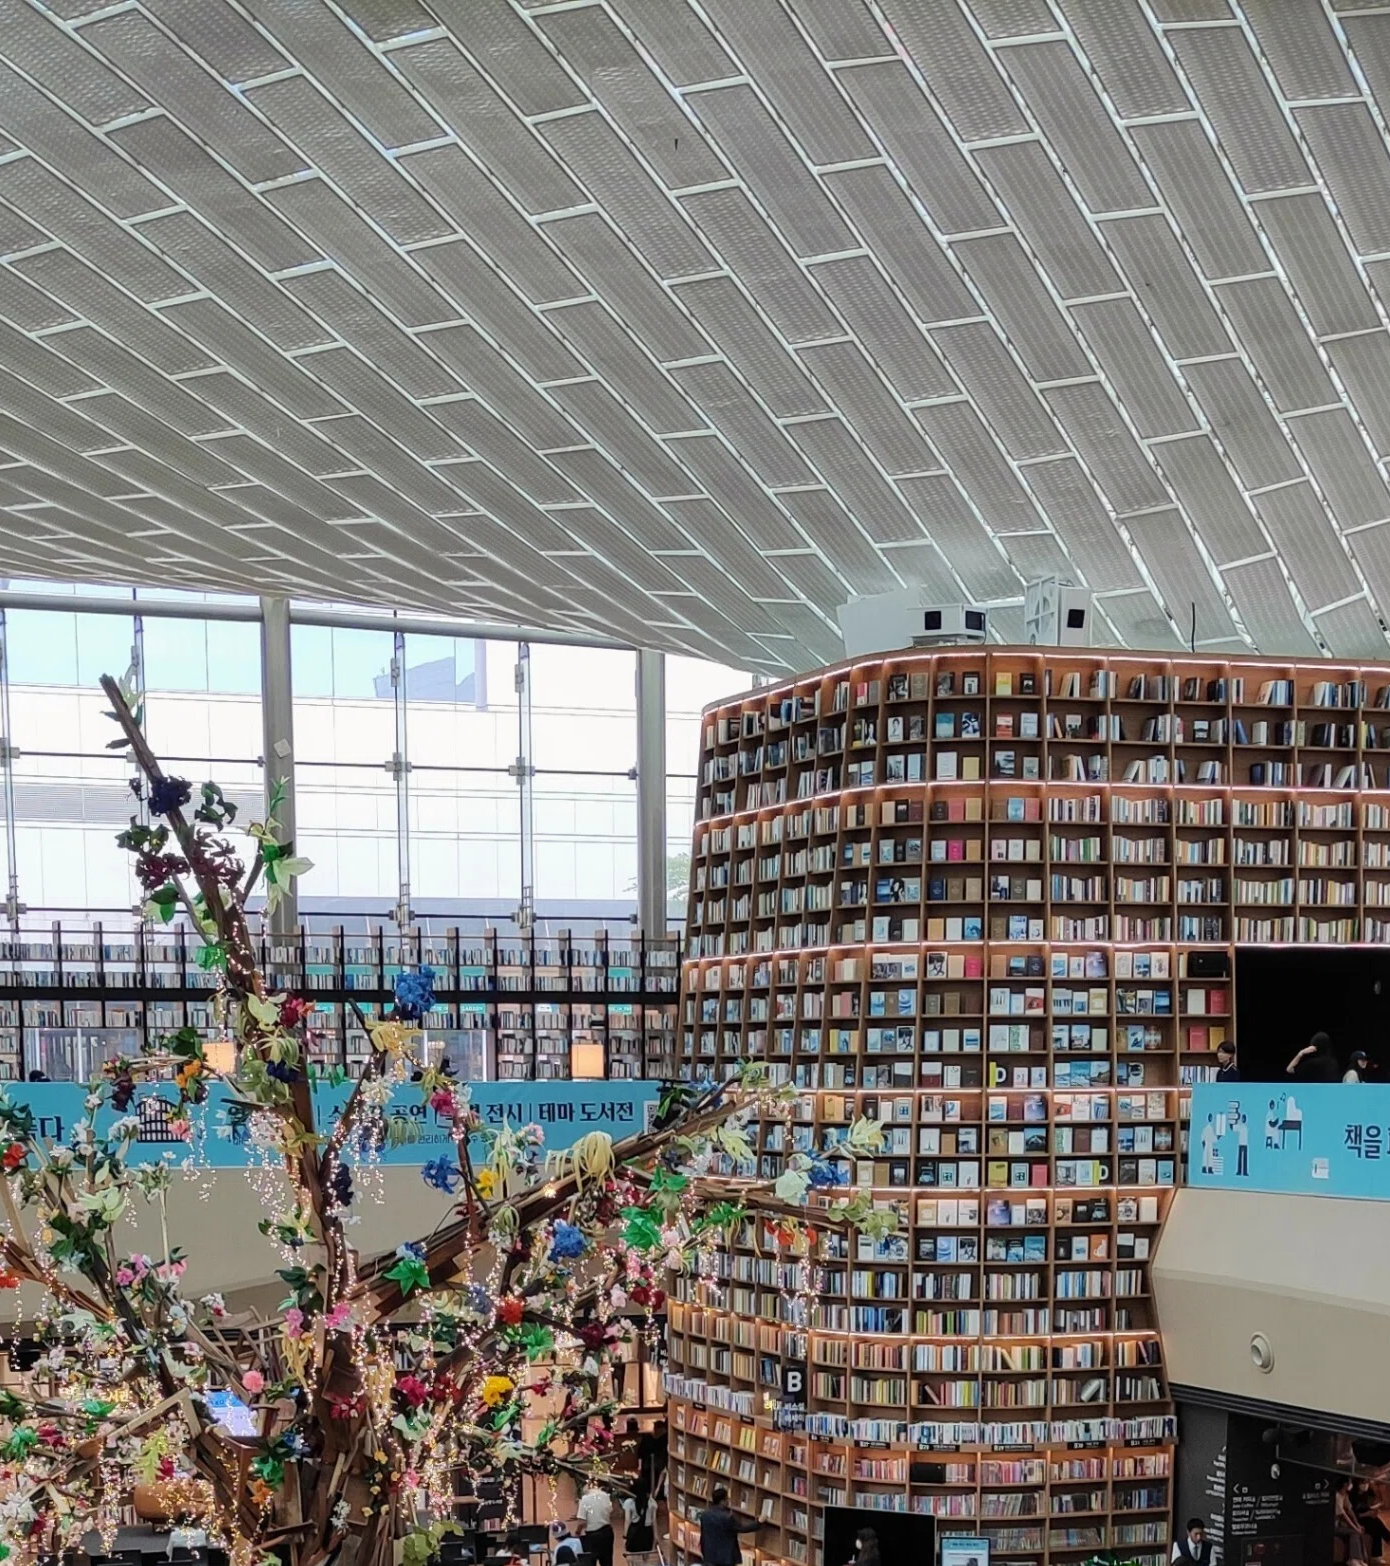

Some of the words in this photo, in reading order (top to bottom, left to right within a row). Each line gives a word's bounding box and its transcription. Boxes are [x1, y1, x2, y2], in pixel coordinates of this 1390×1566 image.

[390, 1105, 427, 1124] 공연
[487, 1103, 522, 1123] 전시
[539, 1102, 575, 1123] 테마
[580, 1102, 634, 1122] 도서전
[1343, 1123, 1384, 1161] 책을
[787, 1371, 803, 1393] B
